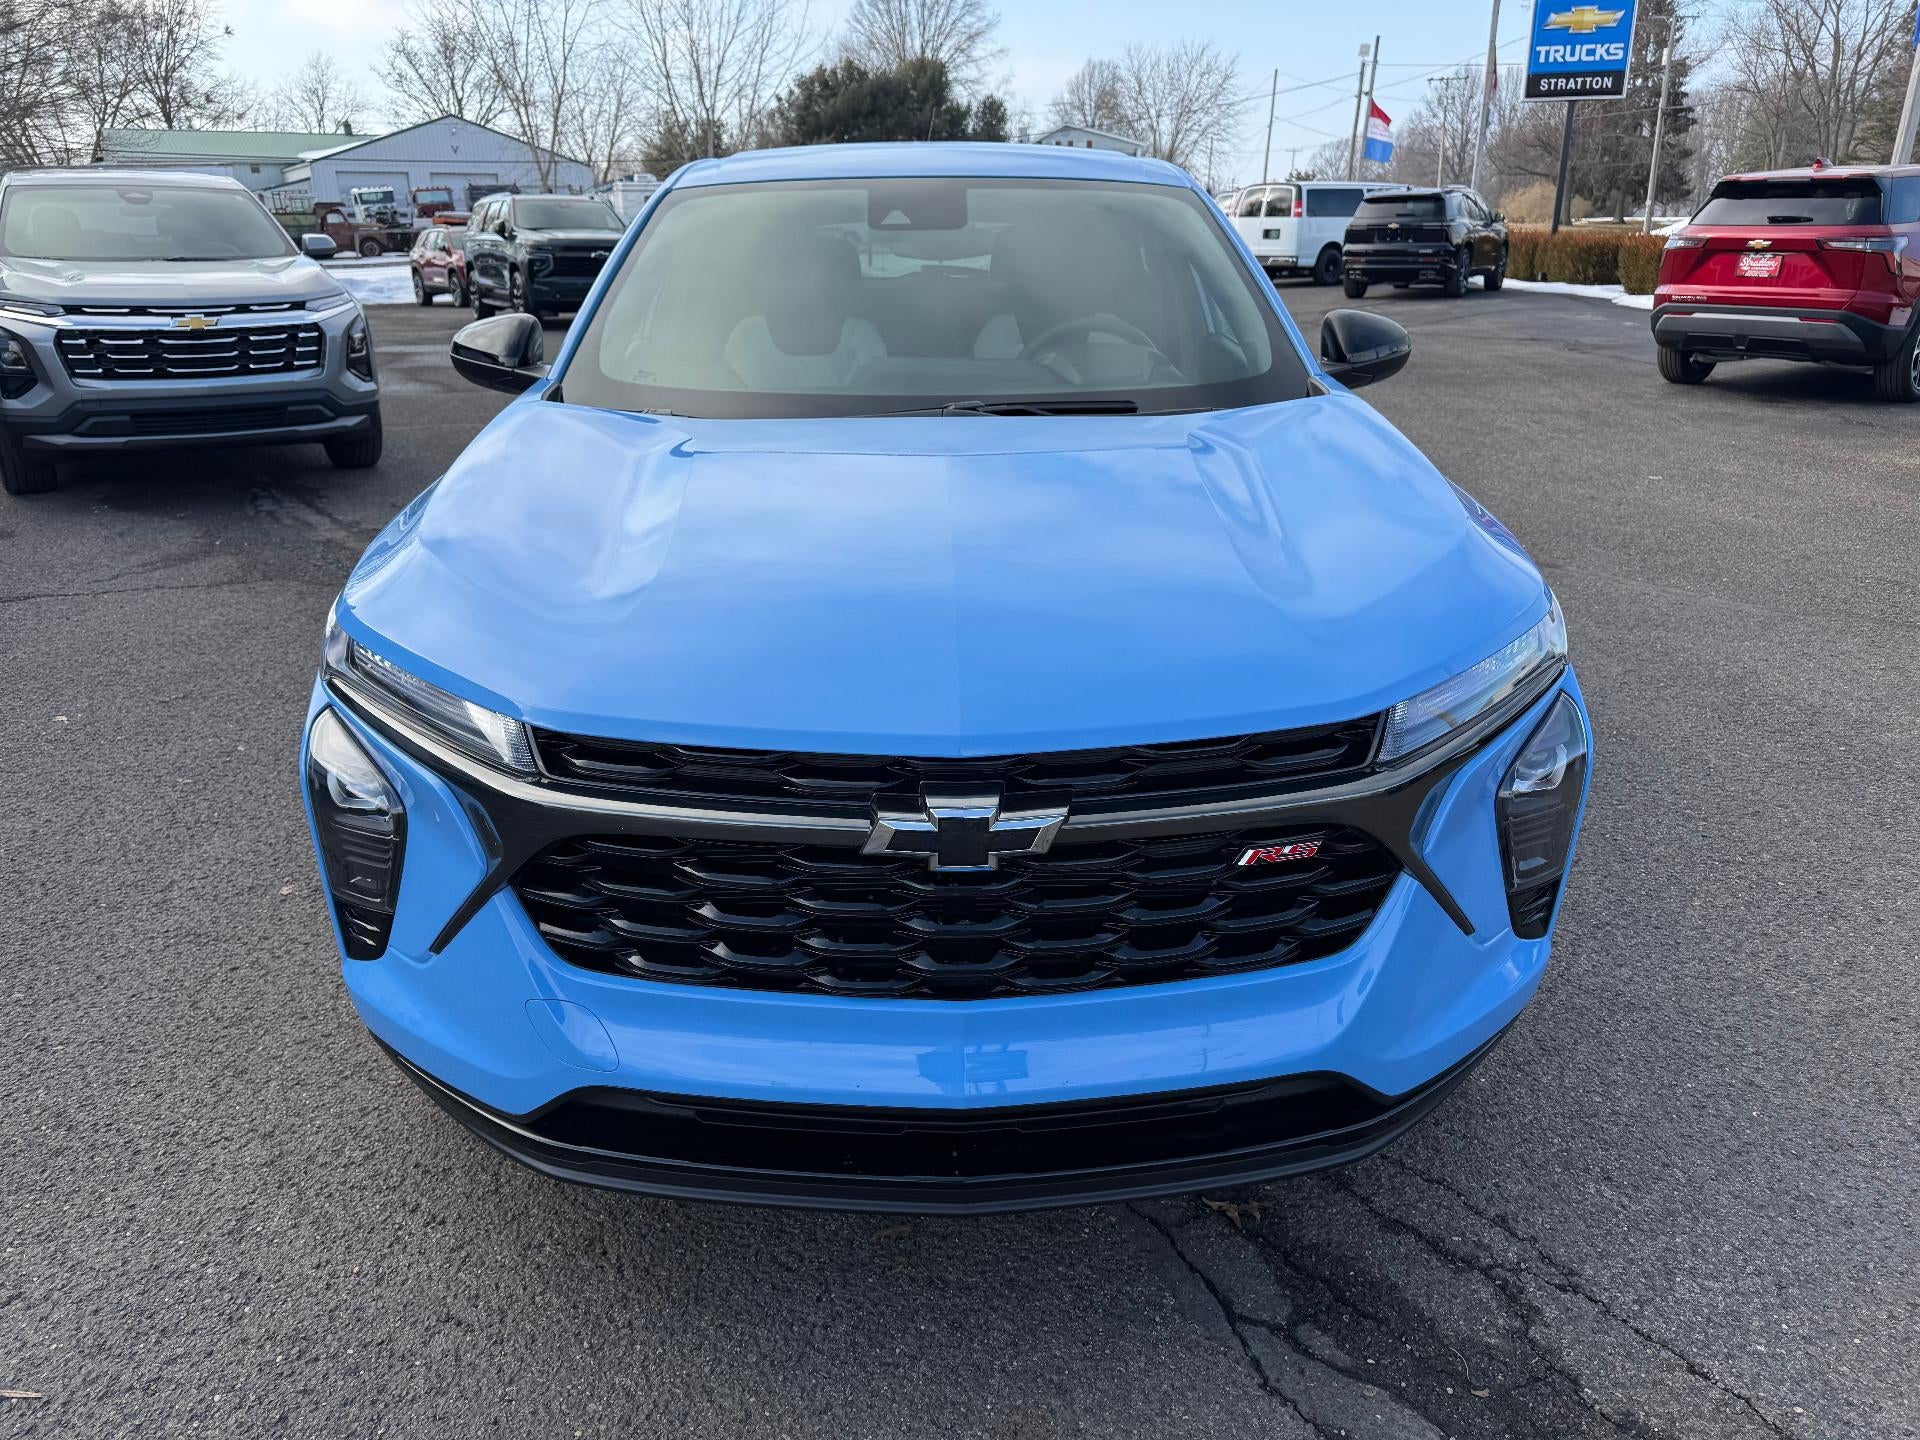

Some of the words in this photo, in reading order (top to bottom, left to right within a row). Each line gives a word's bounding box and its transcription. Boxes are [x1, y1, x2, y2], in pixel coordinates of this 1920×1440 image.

[1536, 43, 1624, 63] TRUCKS
[1540, 77, 1612, 90] STRATTON
[1237, 841, 1322, 865] RS
